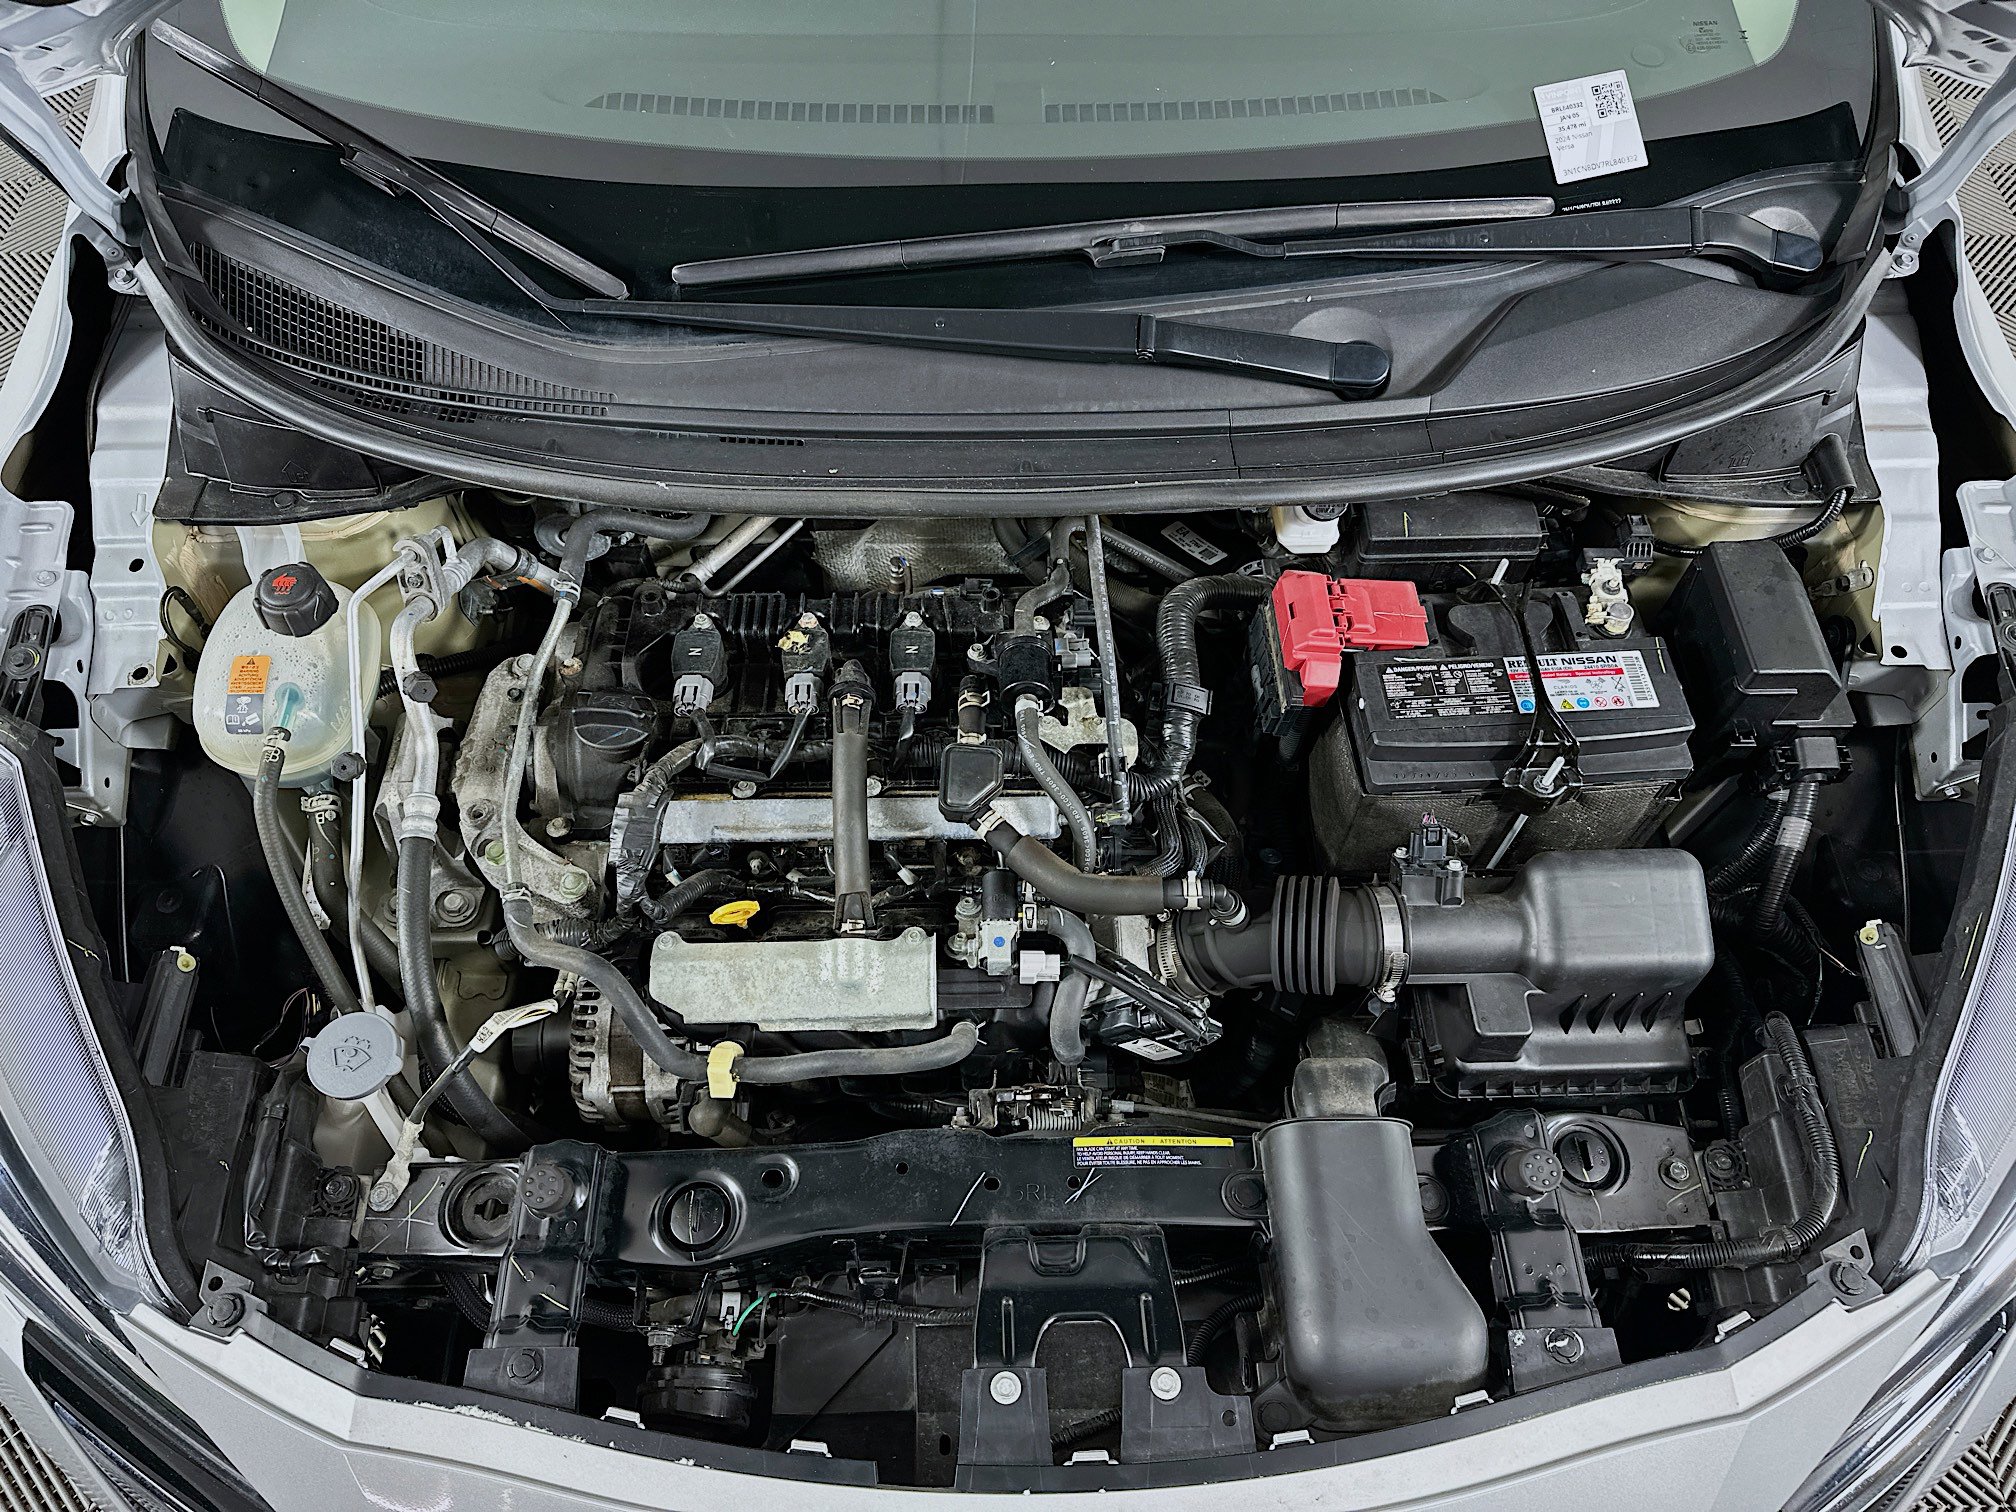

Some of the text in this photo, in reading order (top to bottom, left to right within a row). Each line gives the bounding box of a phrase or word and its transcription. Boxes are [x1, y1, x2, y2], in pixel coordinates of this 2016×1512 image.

[1554, 131, 1593, 144] 2024 Nissan
[1556, 143, 1575, 152] Versa
[1175, 526, 1190, 538] EA
[1560, 655, 1617, 666] NISSAN
[1575, 670, 1592, 678] Special
[1592, 669, 1616, 677] technology
